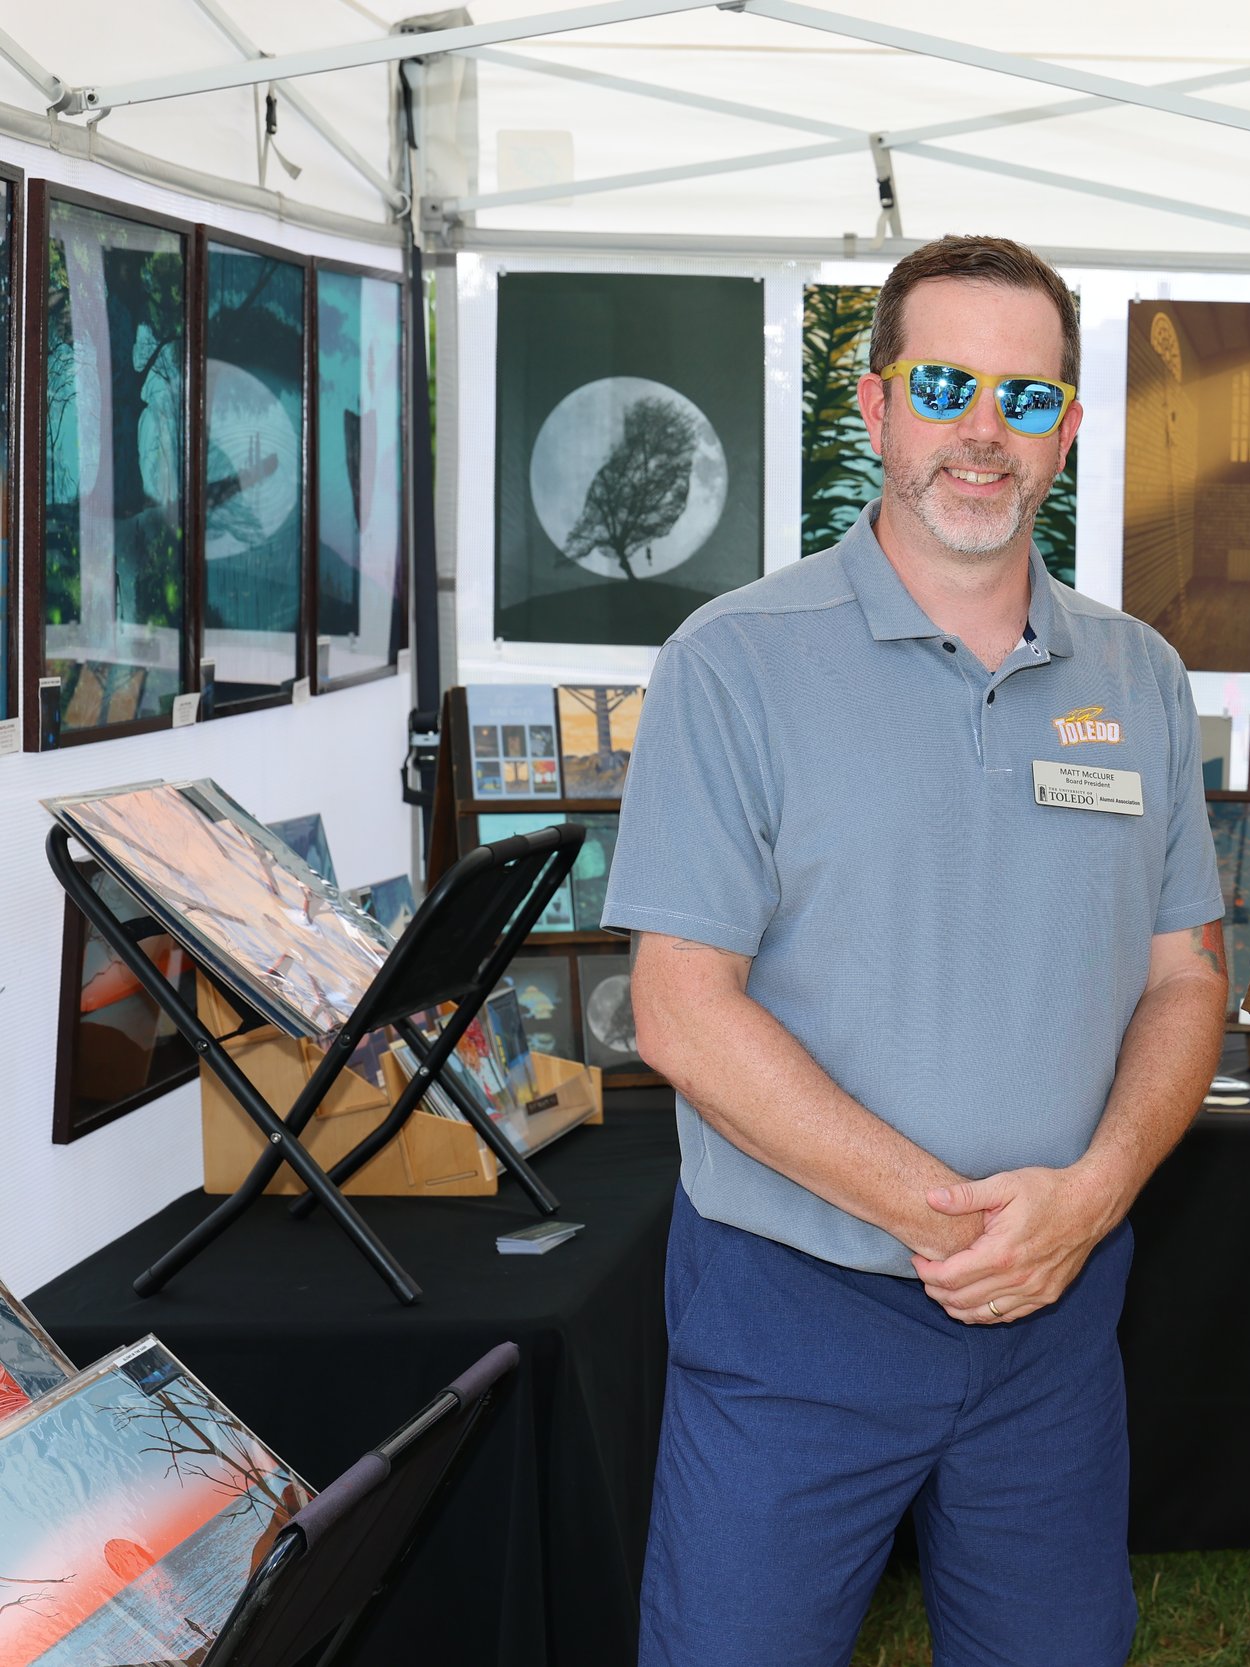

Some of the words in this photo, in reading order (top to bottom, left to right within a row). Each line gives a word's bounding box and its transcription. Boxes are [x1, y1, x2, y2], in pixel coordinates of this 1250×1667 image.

[1054, 718, 1121, 745] TOLEDO
[1060, 768, 1080, 777] MATT
[1082, 771, 1115, 781] McCLURE
[1065, 777, 1083, 785] Board
[1083, 780, 1111, 789] President
[1049, 791, 1094, 806] TOLEDO
[1115, 798, 1141, 806] Association
